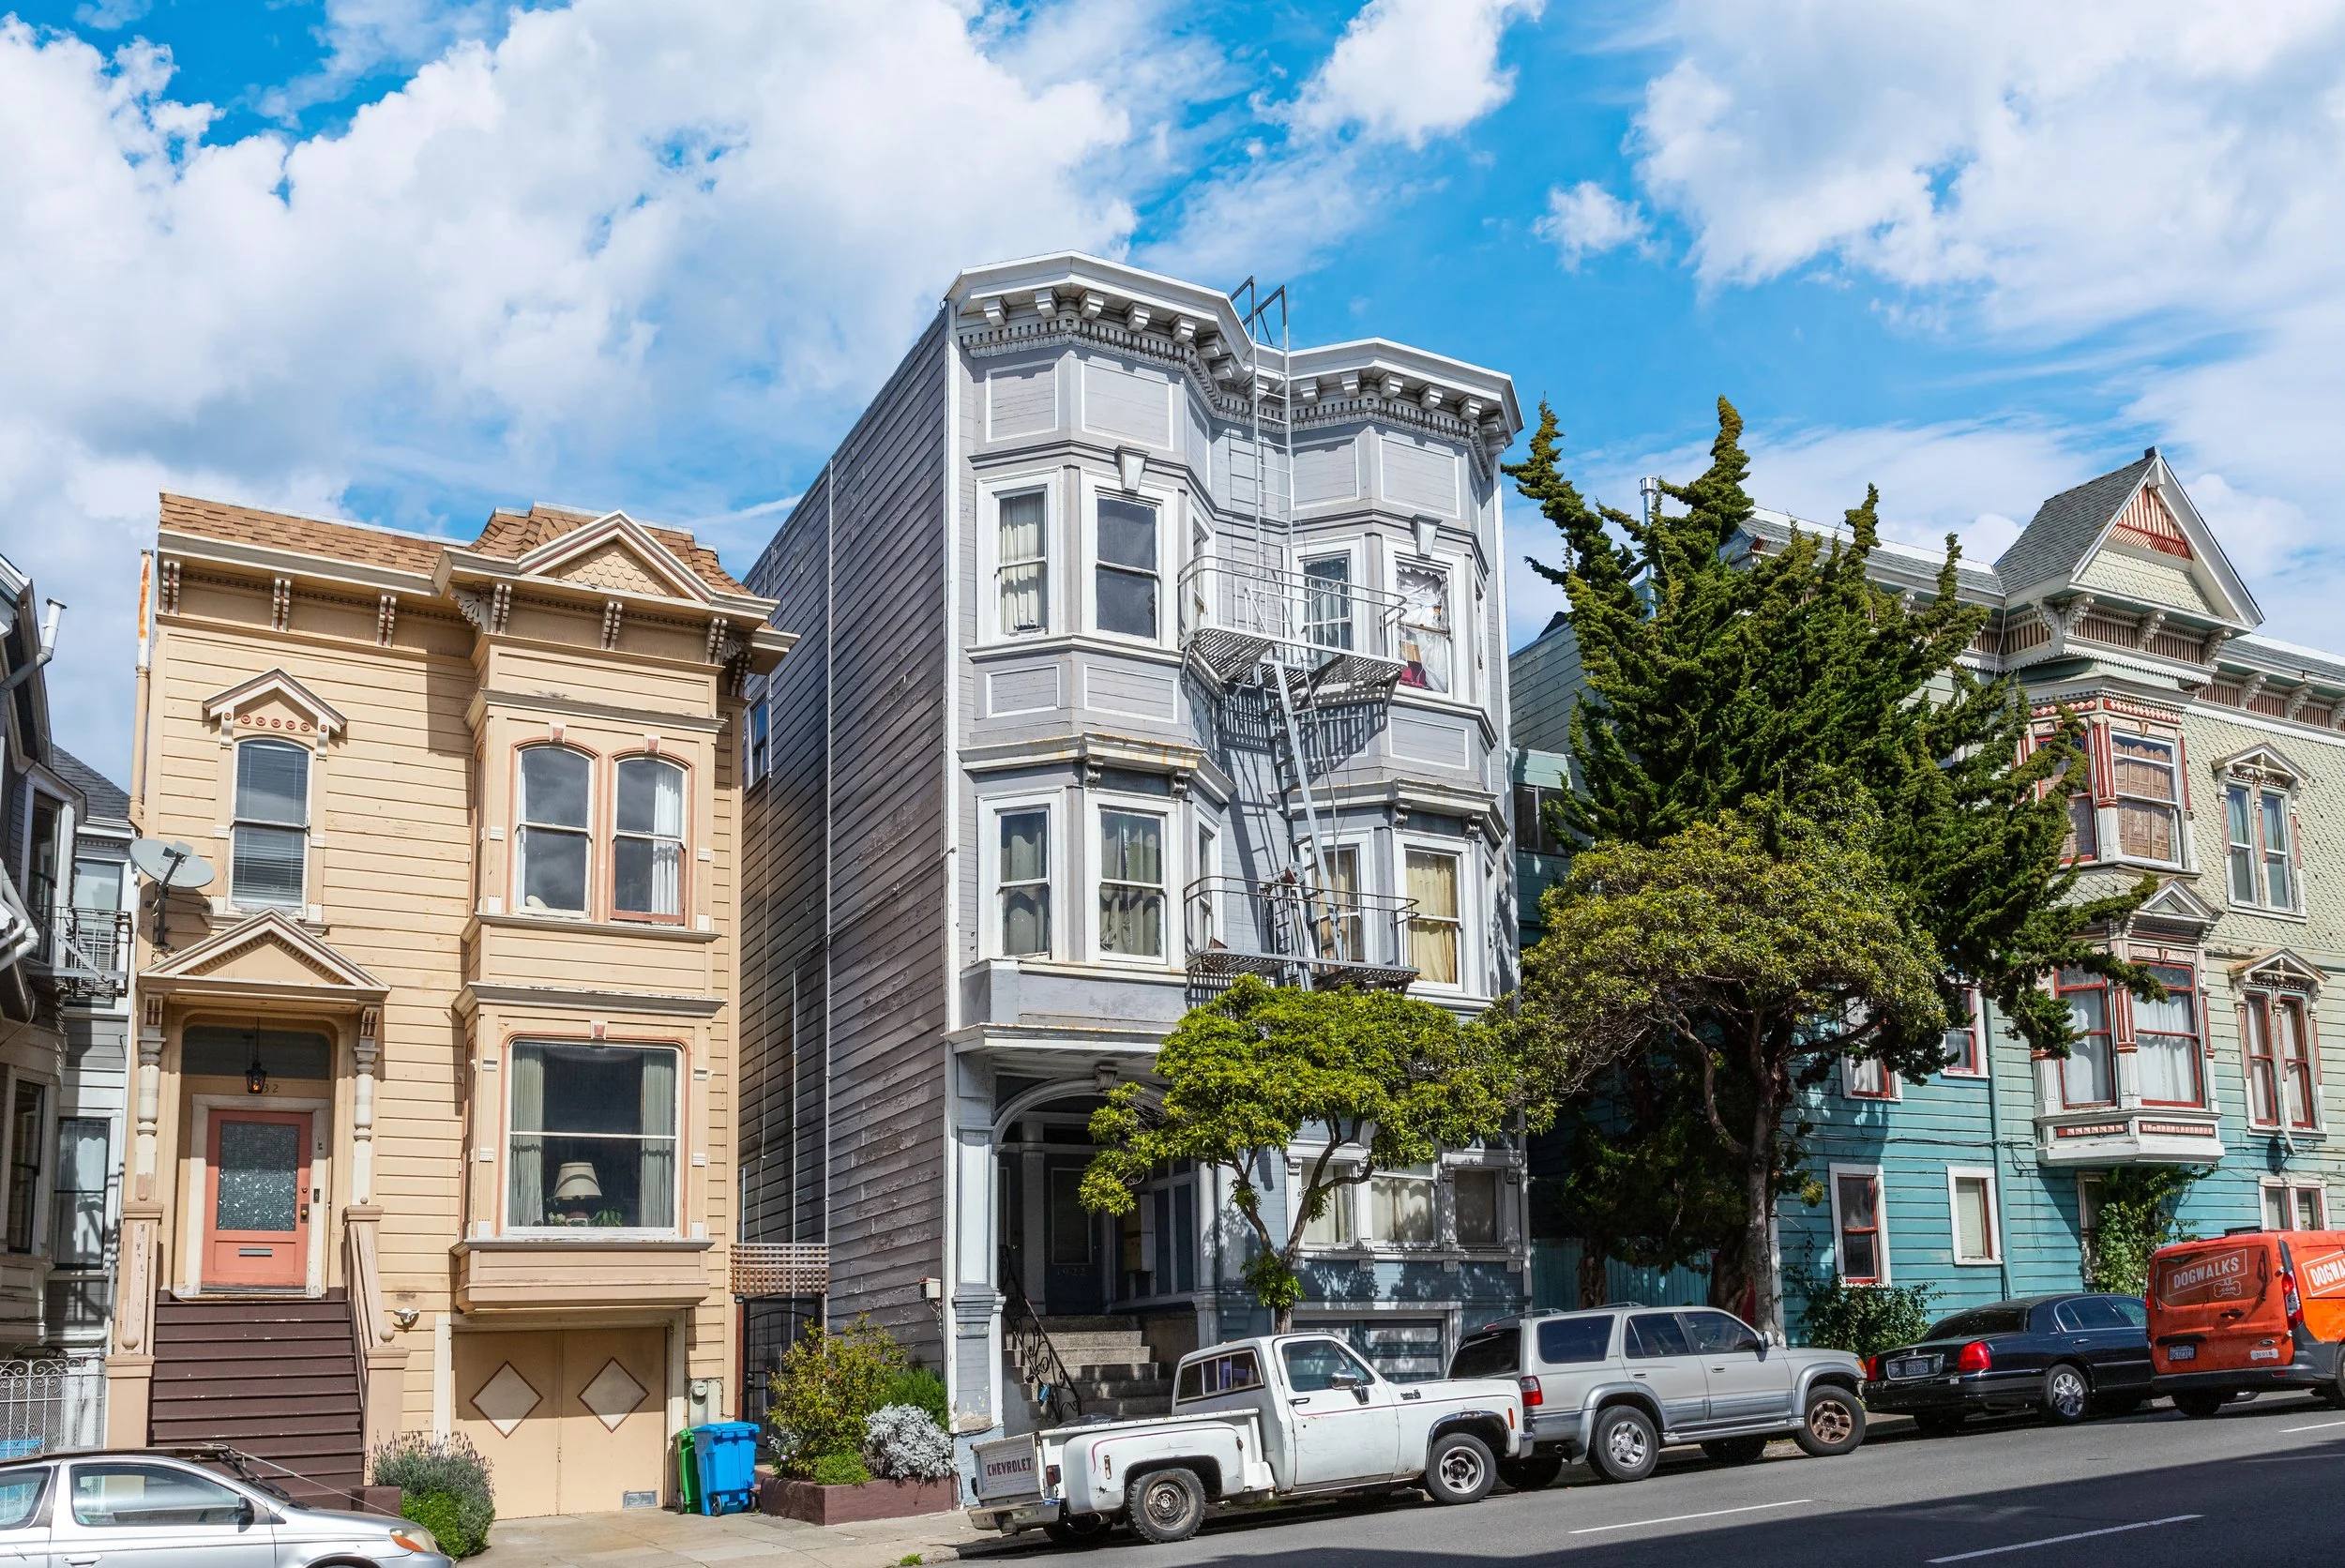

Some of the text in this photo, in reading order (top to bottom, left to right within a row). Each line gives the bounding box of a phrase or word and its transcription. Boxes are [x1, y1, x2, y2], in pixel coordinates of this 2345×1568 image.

[264, 1083, 279, 1093] 32
[2173, 1257, 2240, 1289] DOGWALKS
[2309, 1258, 2345, 1288] DOGWA
[987, 1457, 1032, 1477] CHEVROLET
